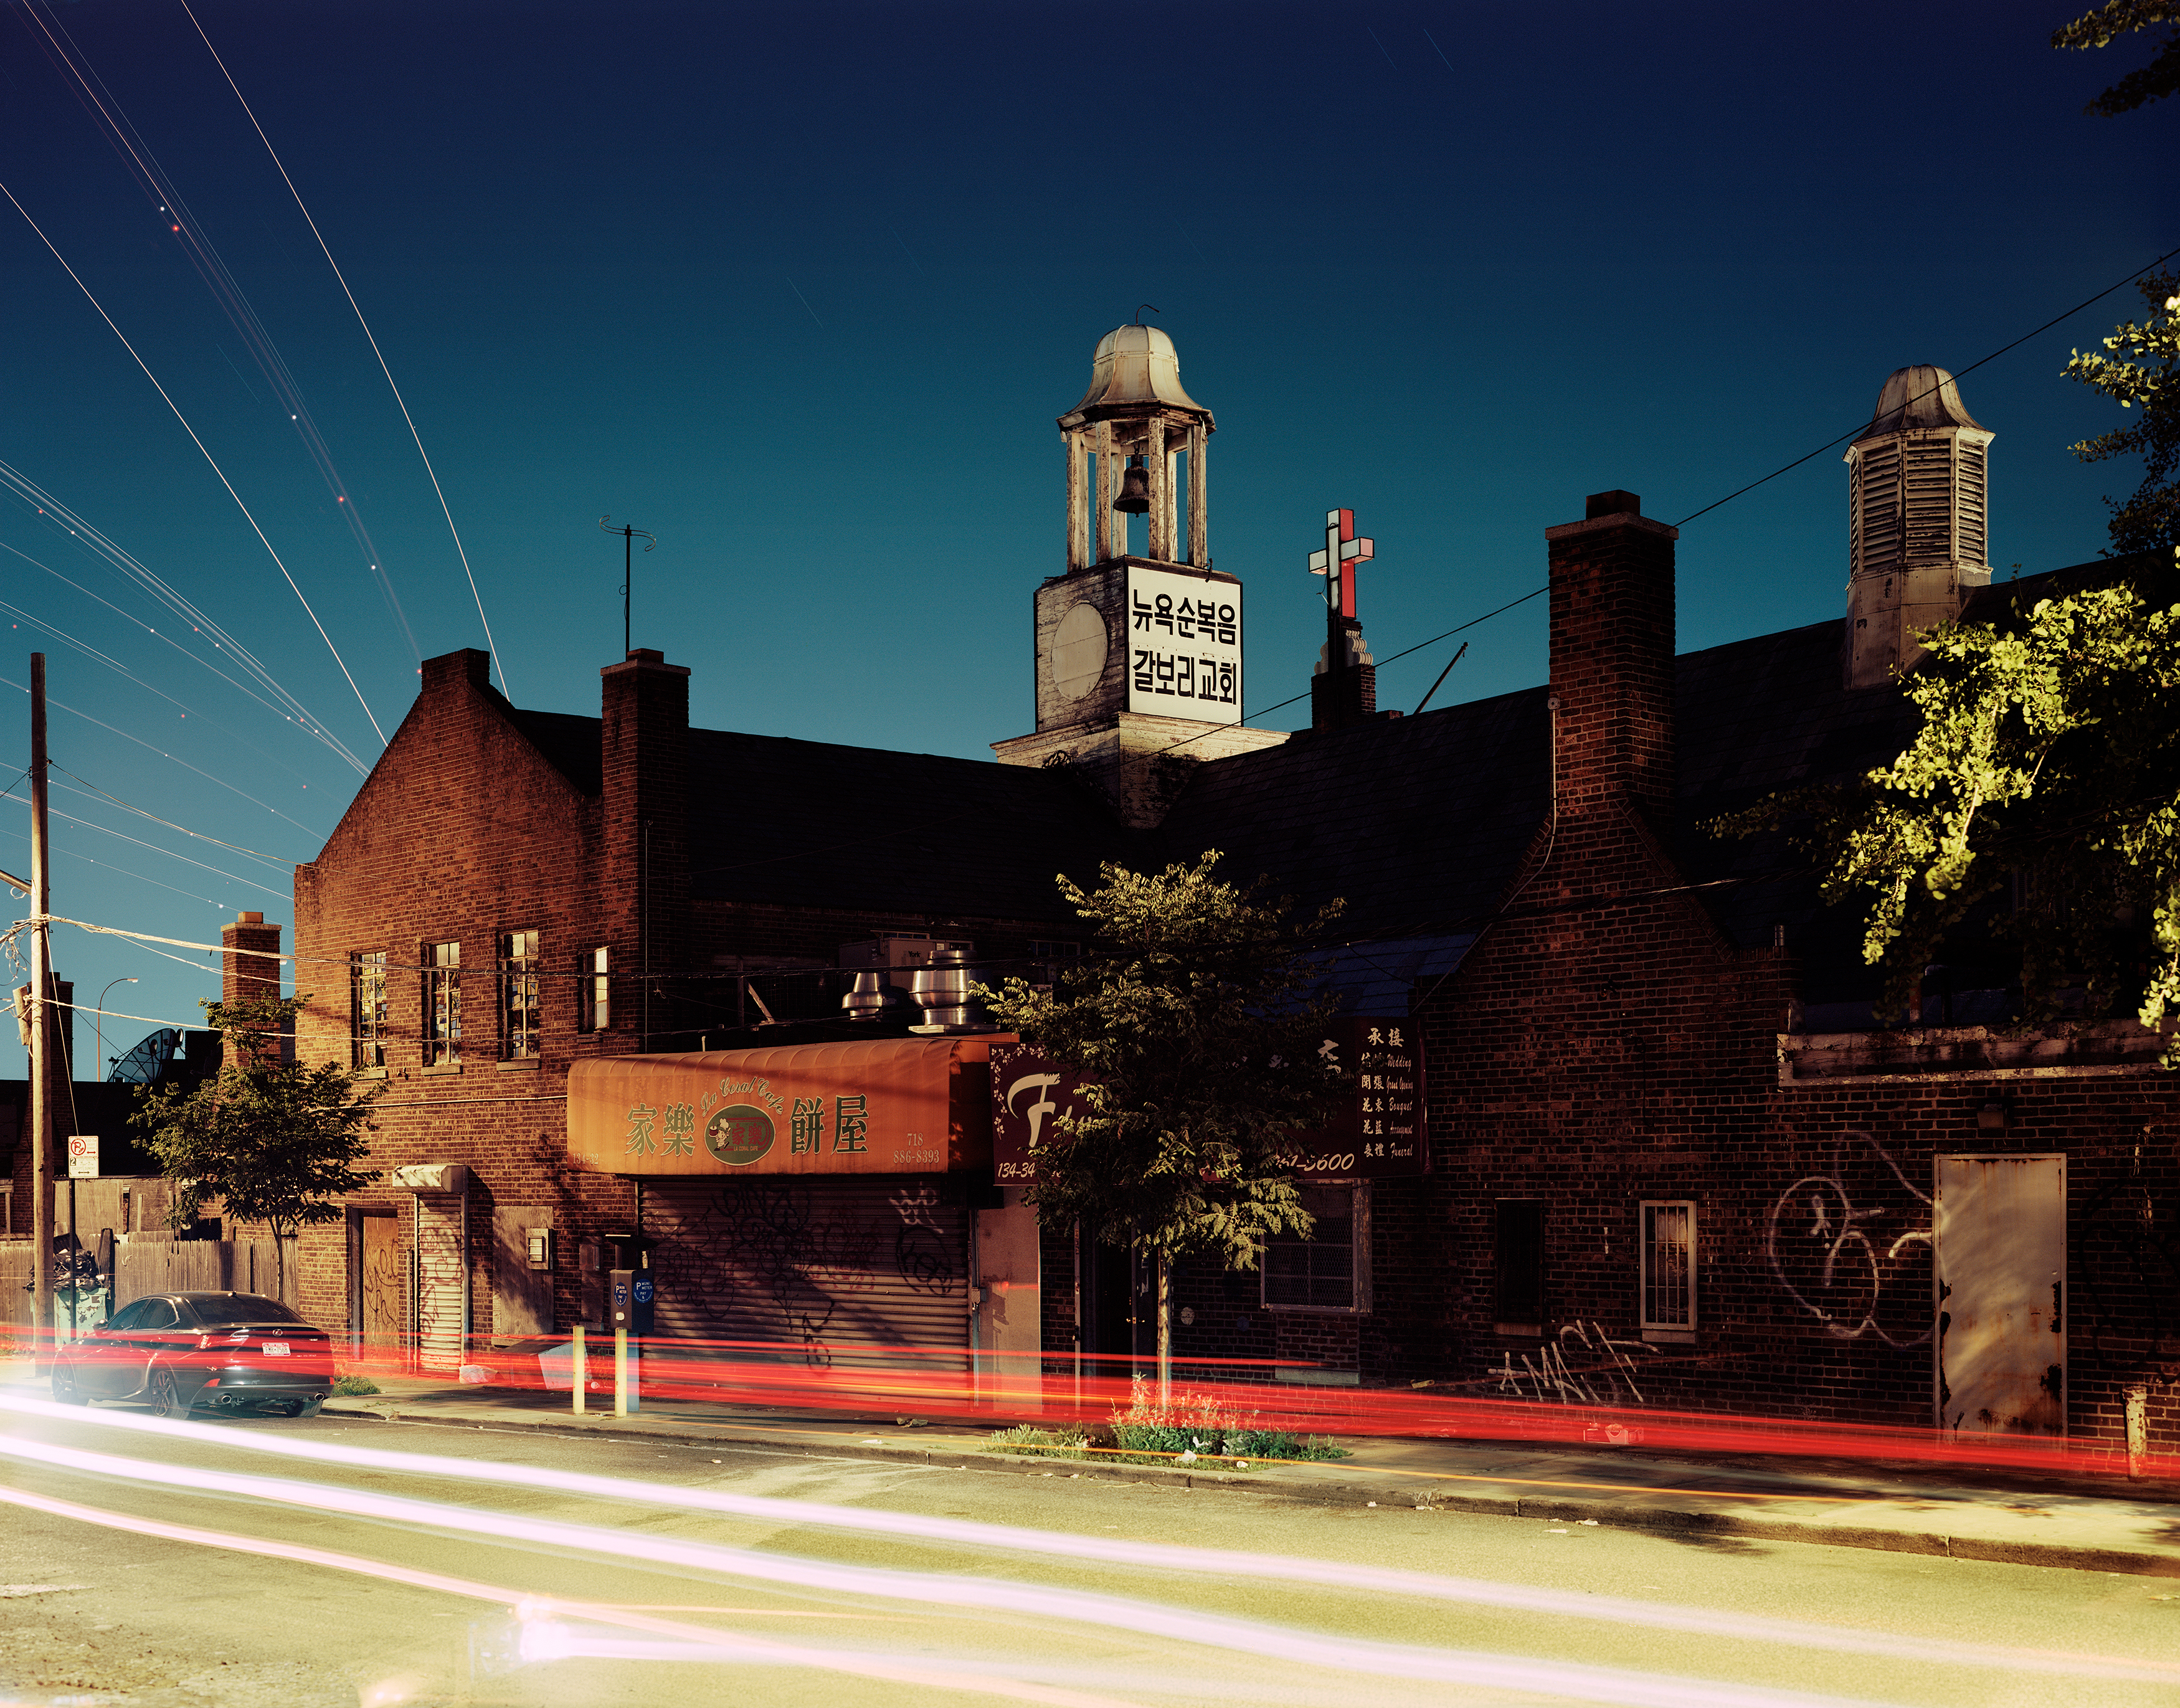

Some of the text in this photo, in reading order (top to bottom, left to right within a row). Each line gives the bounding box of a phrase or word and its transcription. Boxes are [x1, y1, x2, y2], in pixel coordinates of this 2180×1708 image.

[1132, 589, 1236, 645] 뉴욕순복음
[1132, 650, 1236, 705] 갈보리교회
[1367, 1027, 1405, 1047] 承接
[1387, 1054, 1411, 1073] Wedding
[700, 1076, 785, 1117] La Coral Cafe
[1362, 1097, 1384, 1113] 花束
[1389, 1097, 1413, 1116] Bouquet
[625, 1093, 870, 1157] 家樂 餅屋
[732, 1122, 762, 1146] 家樂
[907, 1133, 923, 1146] 718
[572, 1152, 599, 1165] 134-32
[893, 1149, 940, 1164] 886-8393
[1390, 1142, 1413, 1159] Funeral
[998, 1162, 1035, 1178] 134-34
[616, 1285, 620, 1293] P
[637, 1282, 642, 1290] P
